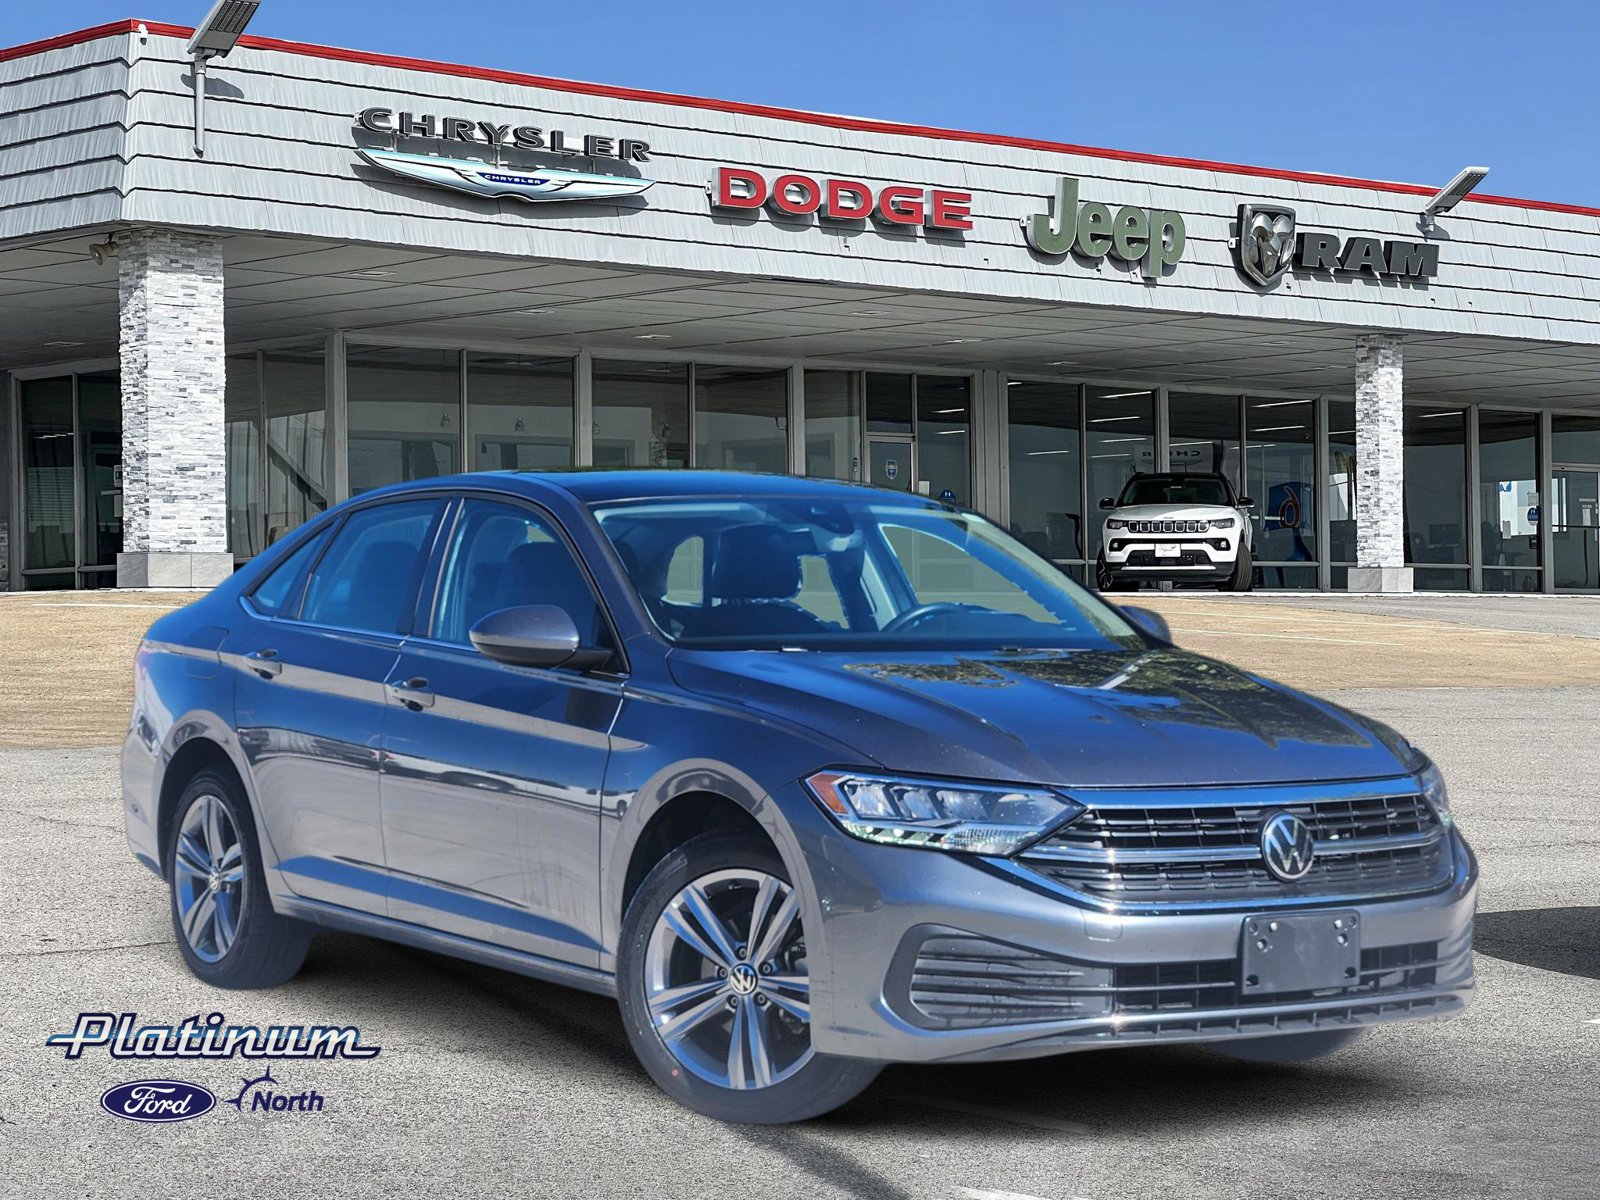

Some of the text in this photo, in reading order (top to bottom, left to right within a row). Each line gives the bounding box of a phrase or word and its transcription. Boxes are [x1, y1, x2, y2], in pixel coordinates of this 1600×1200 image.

[359, 106, 651, 162] CHRYSLER
[484, 174, 541, 185] CHRYSLER
[712, 167, 974, 230] DODGE
[1027, 177, 1186, 278] Jeep
[1300, 231, 1440, 278] RAM
